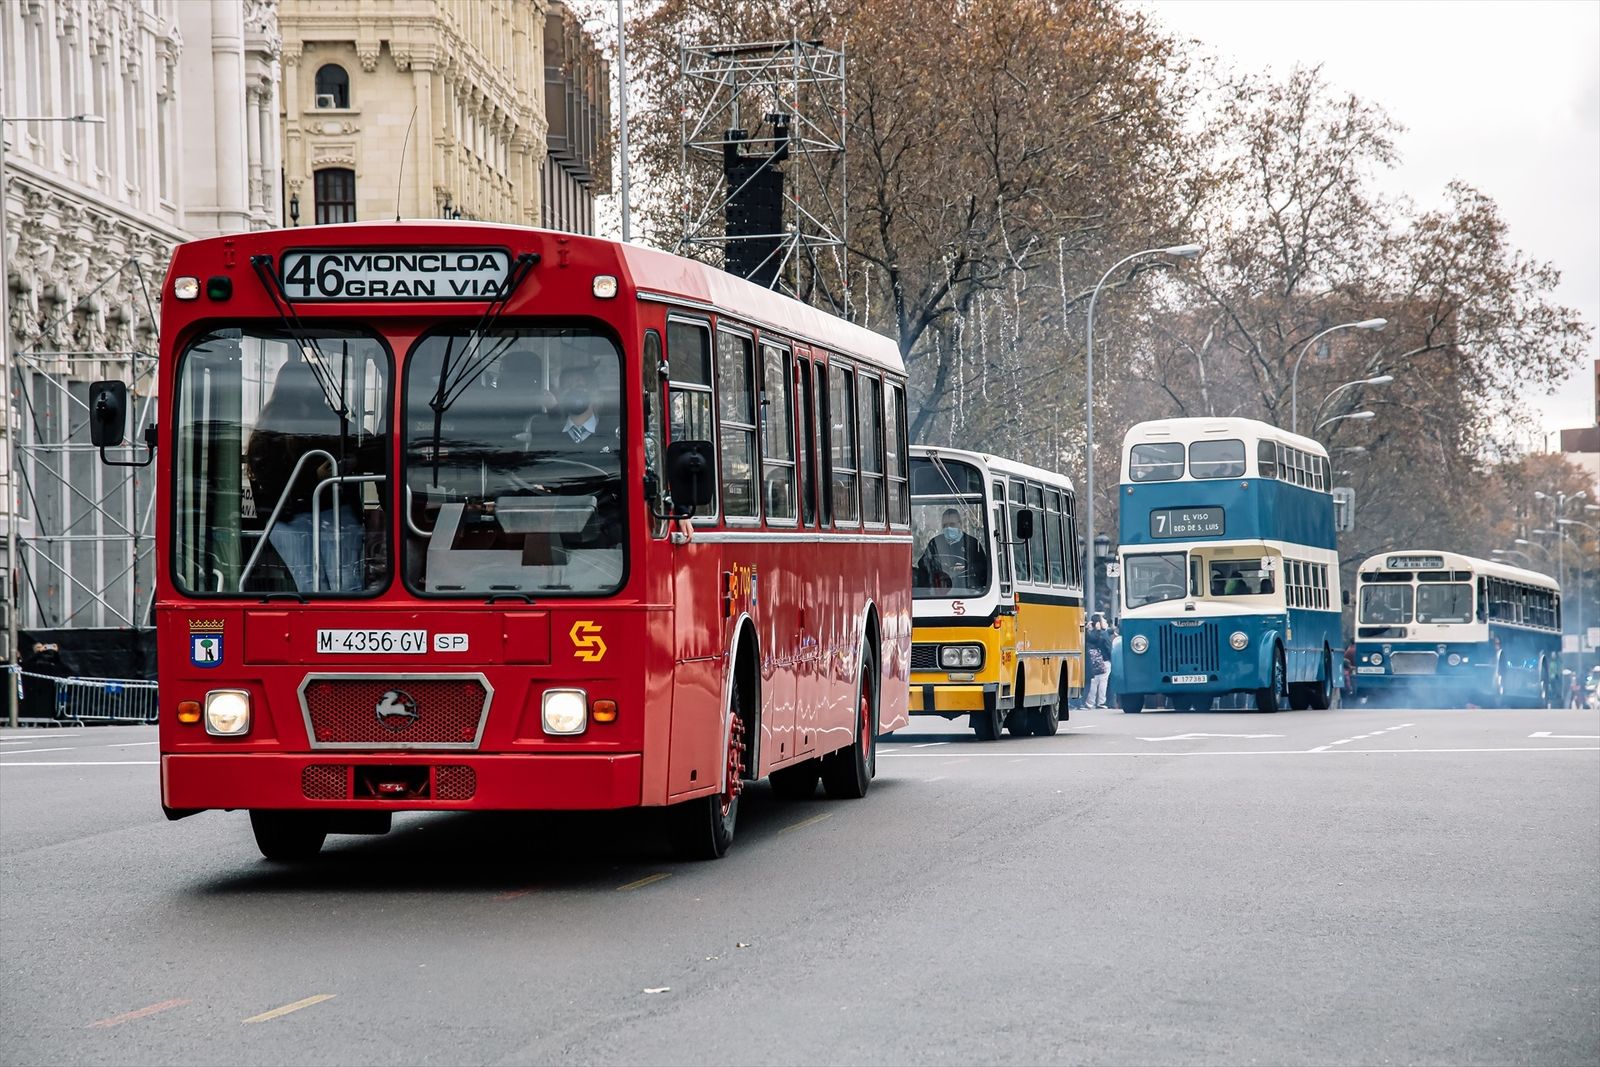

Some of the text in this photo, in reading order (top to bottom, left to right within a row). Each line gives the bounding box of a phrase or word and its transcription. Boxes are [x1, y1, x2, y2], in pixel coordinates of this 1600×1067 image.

[285, 254, 501, 297] 46 MONCLOA
[344, 279, 502, 297] GRAN VIA
[1156, 515, 1166, 533] 7
[1391, 557, 1398, 568] 2
[438, 636, 464, 649] SP
